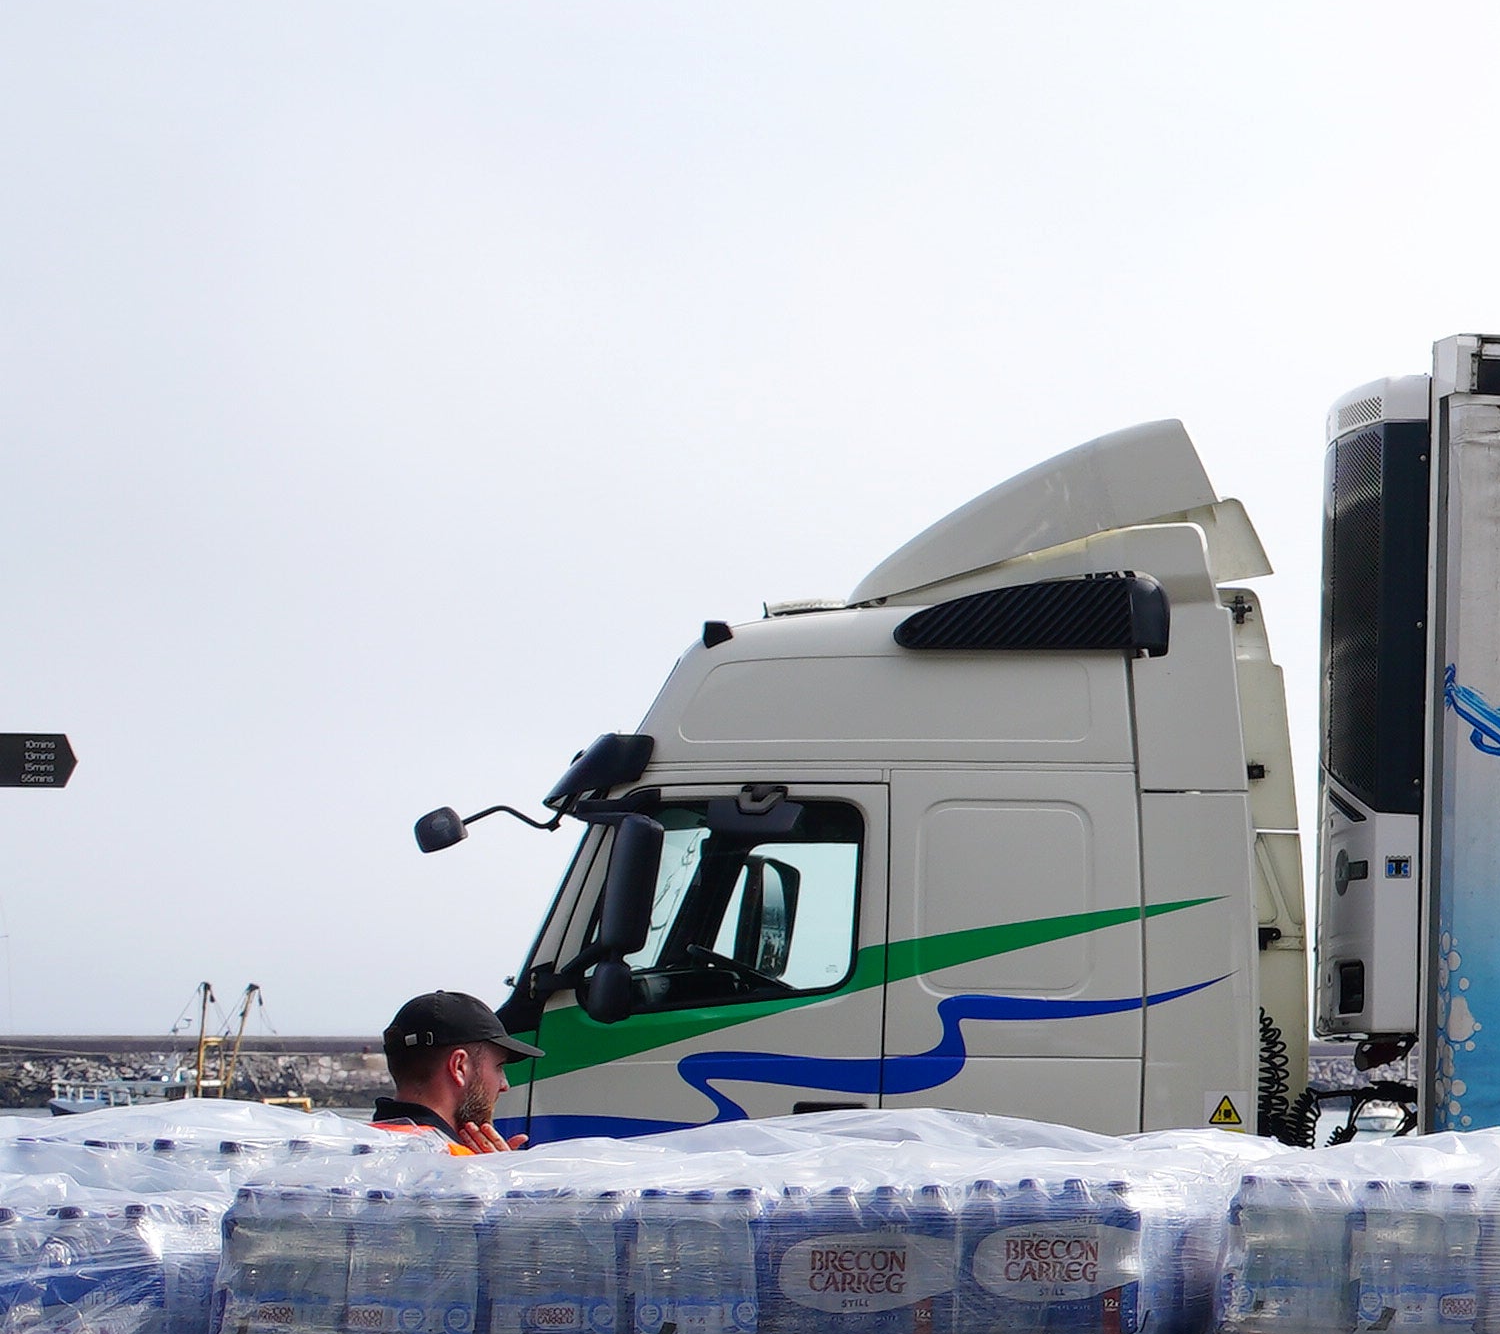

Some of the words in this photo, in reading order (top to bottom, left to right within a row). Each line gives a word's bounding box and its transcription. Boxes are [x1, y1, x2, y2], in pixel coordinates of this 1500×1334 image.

[1006, 1239, 1098, 1260] BRECON
[810, 1249, 906, 1273] BRECON
[809, 1272, 905, 1293] CARREG
[1004, 1262, 1098, 1282] CARREG
